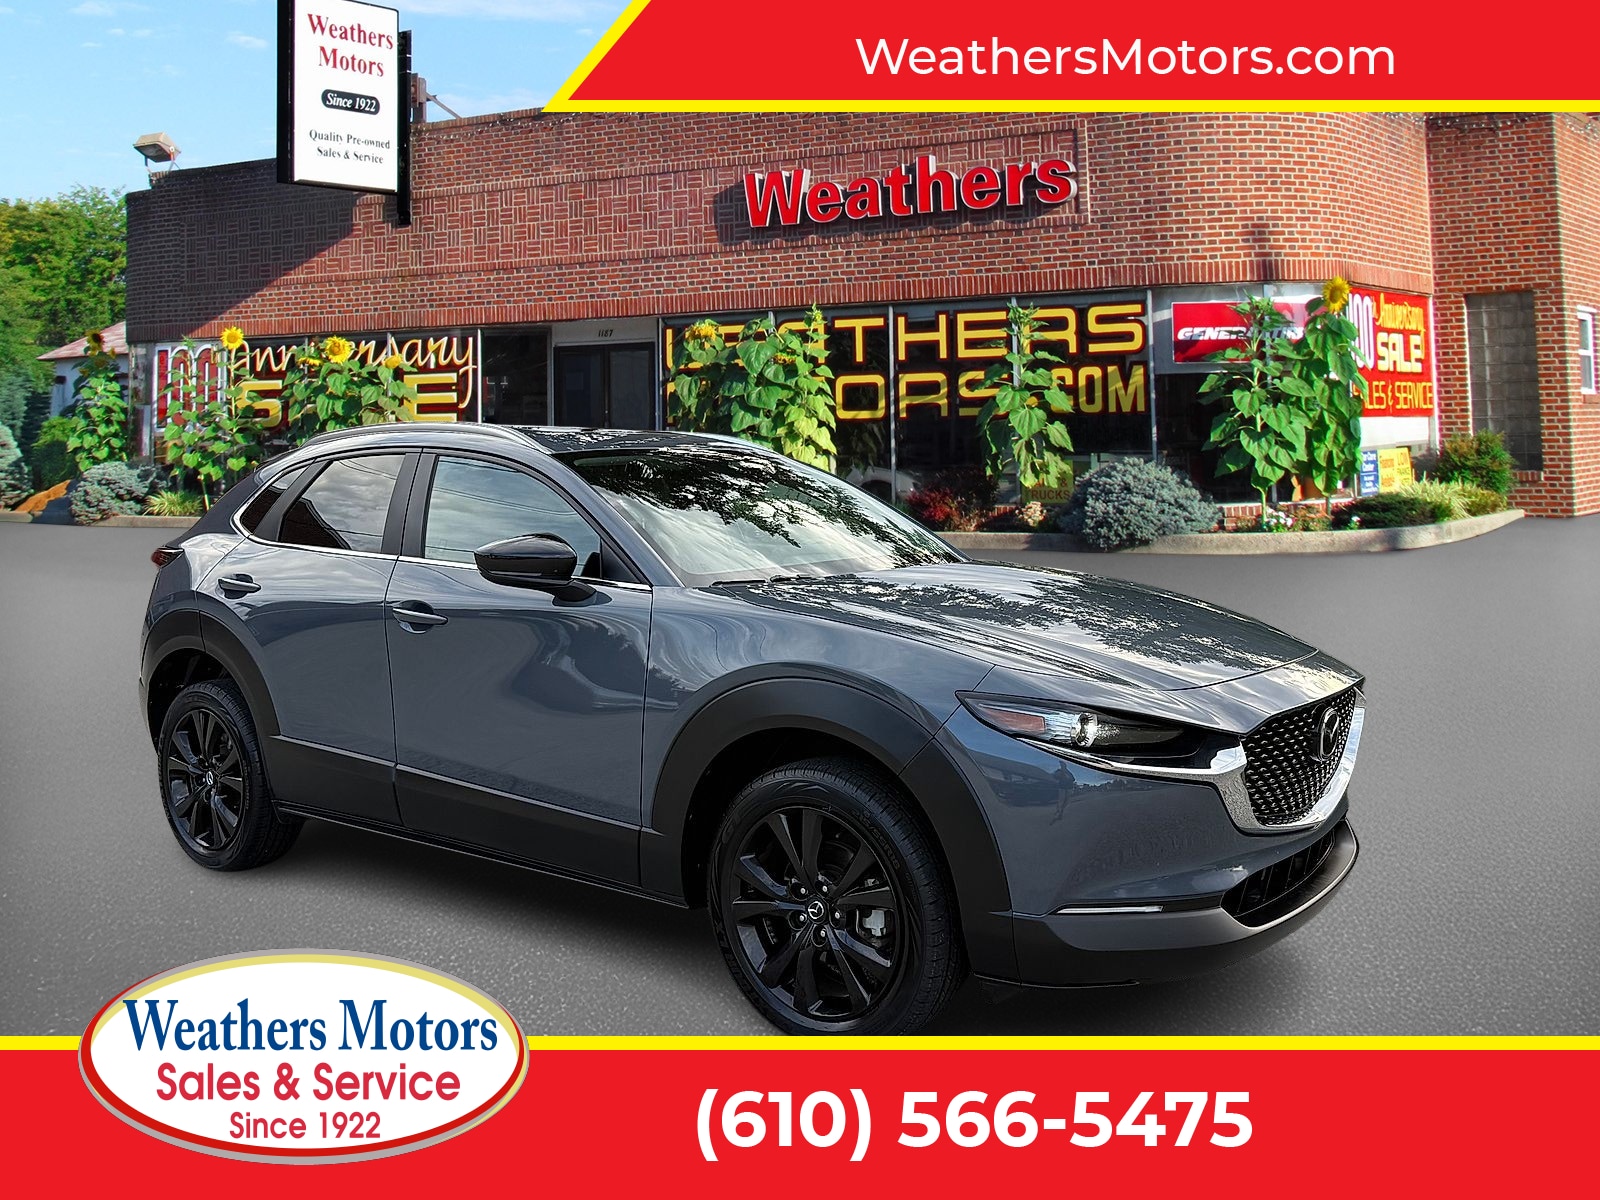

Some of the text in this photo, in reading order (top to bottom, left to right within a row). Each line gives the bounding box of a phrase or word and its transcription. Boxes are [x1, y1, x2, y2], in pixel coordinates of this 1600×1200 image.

[307, 13, 394, 50] Weathers
[319, 46, 385, 77] Motors
[326, 93, 376, 112] Since 1922
[309, 129, 391, 150] Quality Pre-owned
[317, 146, 384, 164] Sales & Service
[743, 155, 1077, 229] Weathers
[598, 329, 614, 338] 1187
[1177, 326, 1304, 340] GENERORS
[1377, 332, 1422, 373] SALE
[227, 336, 477, 409] Annrsary
[236, 373, 458, 427] SE
[1395, 381, 1434, 409] SERVICE
